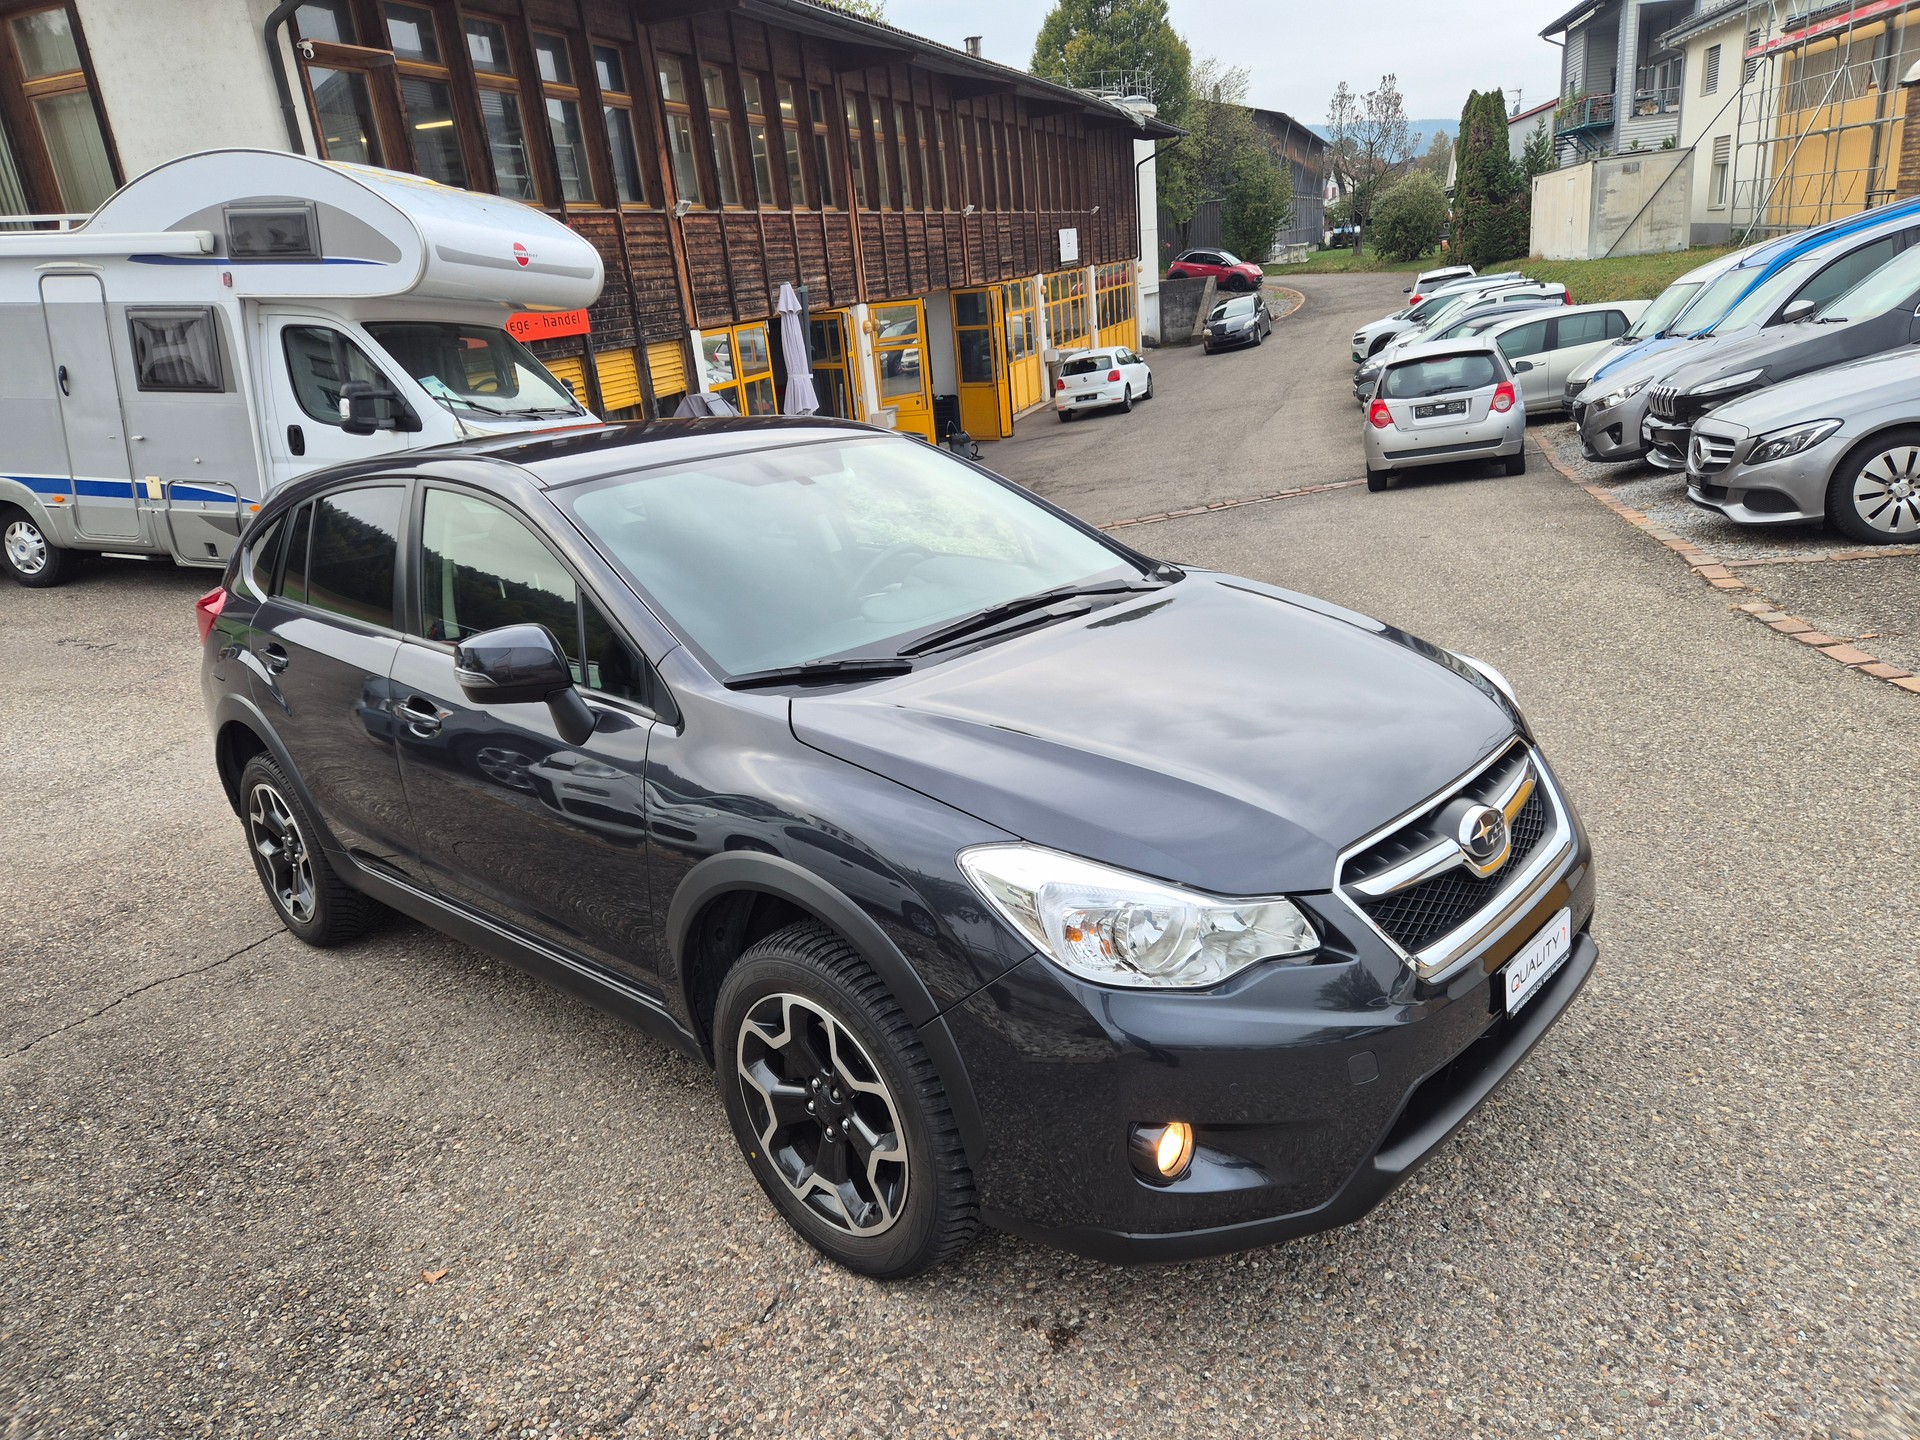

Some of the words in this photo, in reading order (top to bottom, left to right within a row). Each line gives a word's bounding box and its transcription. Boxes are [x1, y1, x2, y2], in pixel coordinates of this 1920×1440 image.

[543, 312, 580, 328] handel
[1511, 931, 1560, 993] QUALITY
[1562, 926, 1567, 942] 1
